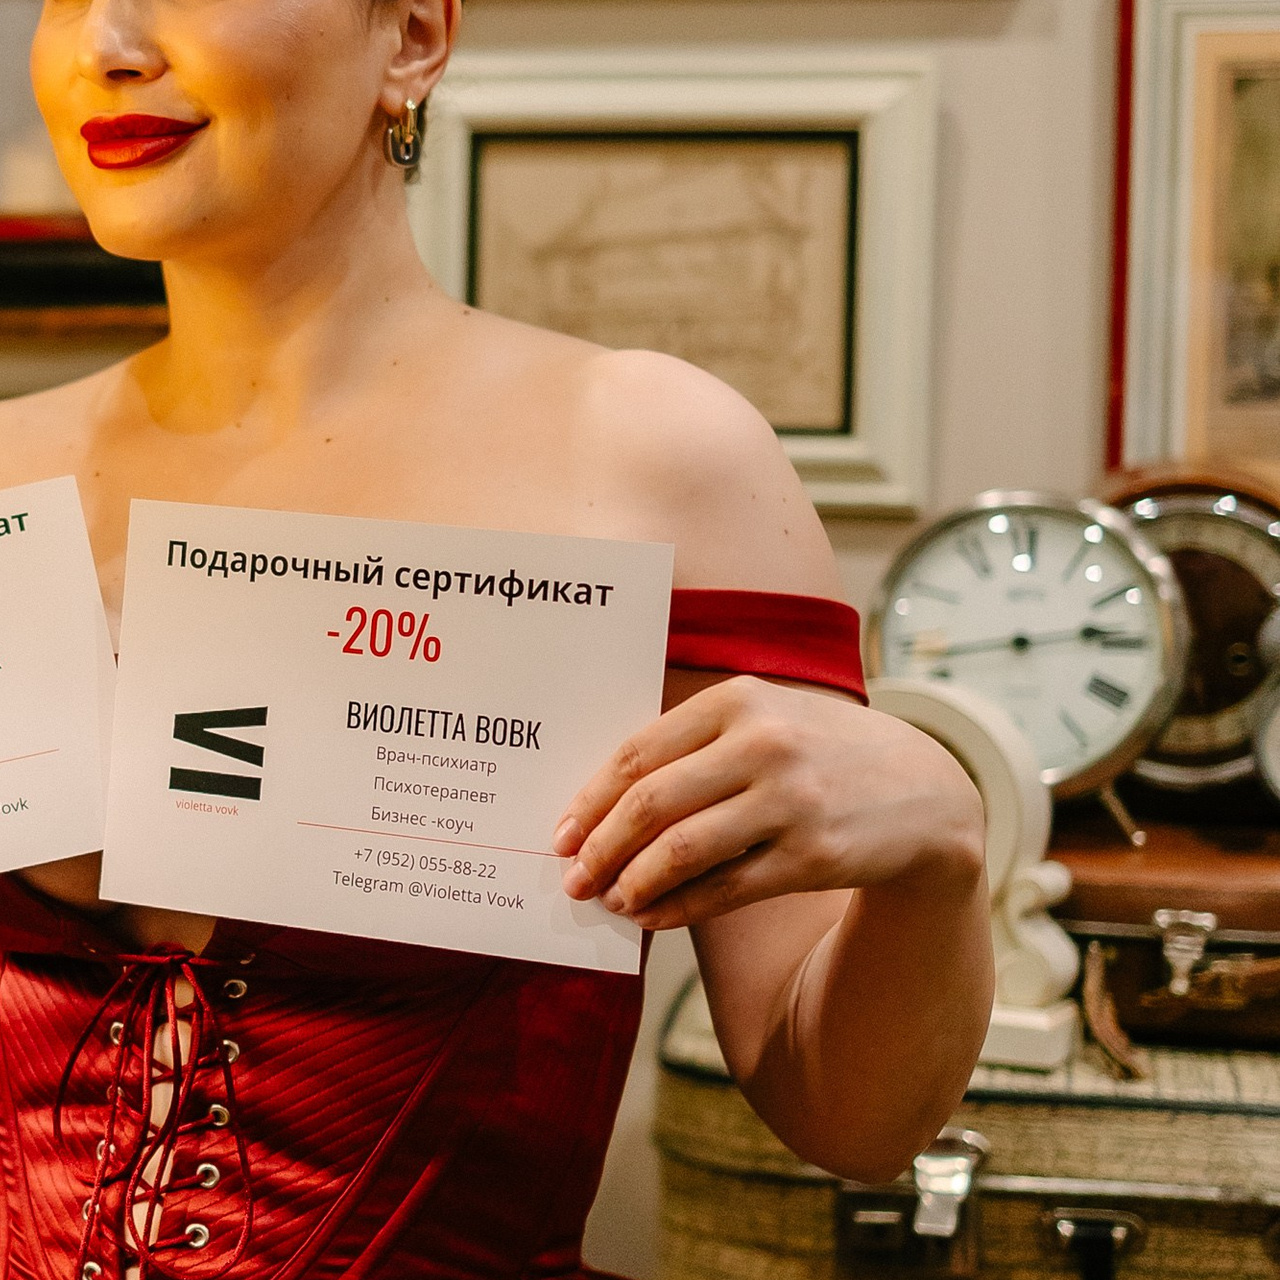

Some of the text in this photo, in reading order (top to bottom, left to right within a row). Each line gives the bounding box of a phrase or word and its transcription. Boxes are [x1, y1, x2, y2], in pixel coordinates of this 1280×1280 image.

[168, 540, 614, 606] Подарочный сертификат
[327, 606, 441, 662] -20%
[347, 701, 541, 750] ВИОЛЕТТА ВОВК
[377, 746, 497, 777] Врач-психиатр
[374, 776, 497, 804] Психотерапевт
[176, 799, 239, 816] violetta vovk
[371, 806, 474, 835] Бизнес -коуч
[354, 848, 496, 879] +7 (952) 055-88-22
[333, 870, 524, 910] Telegram @Violetta Vovk
